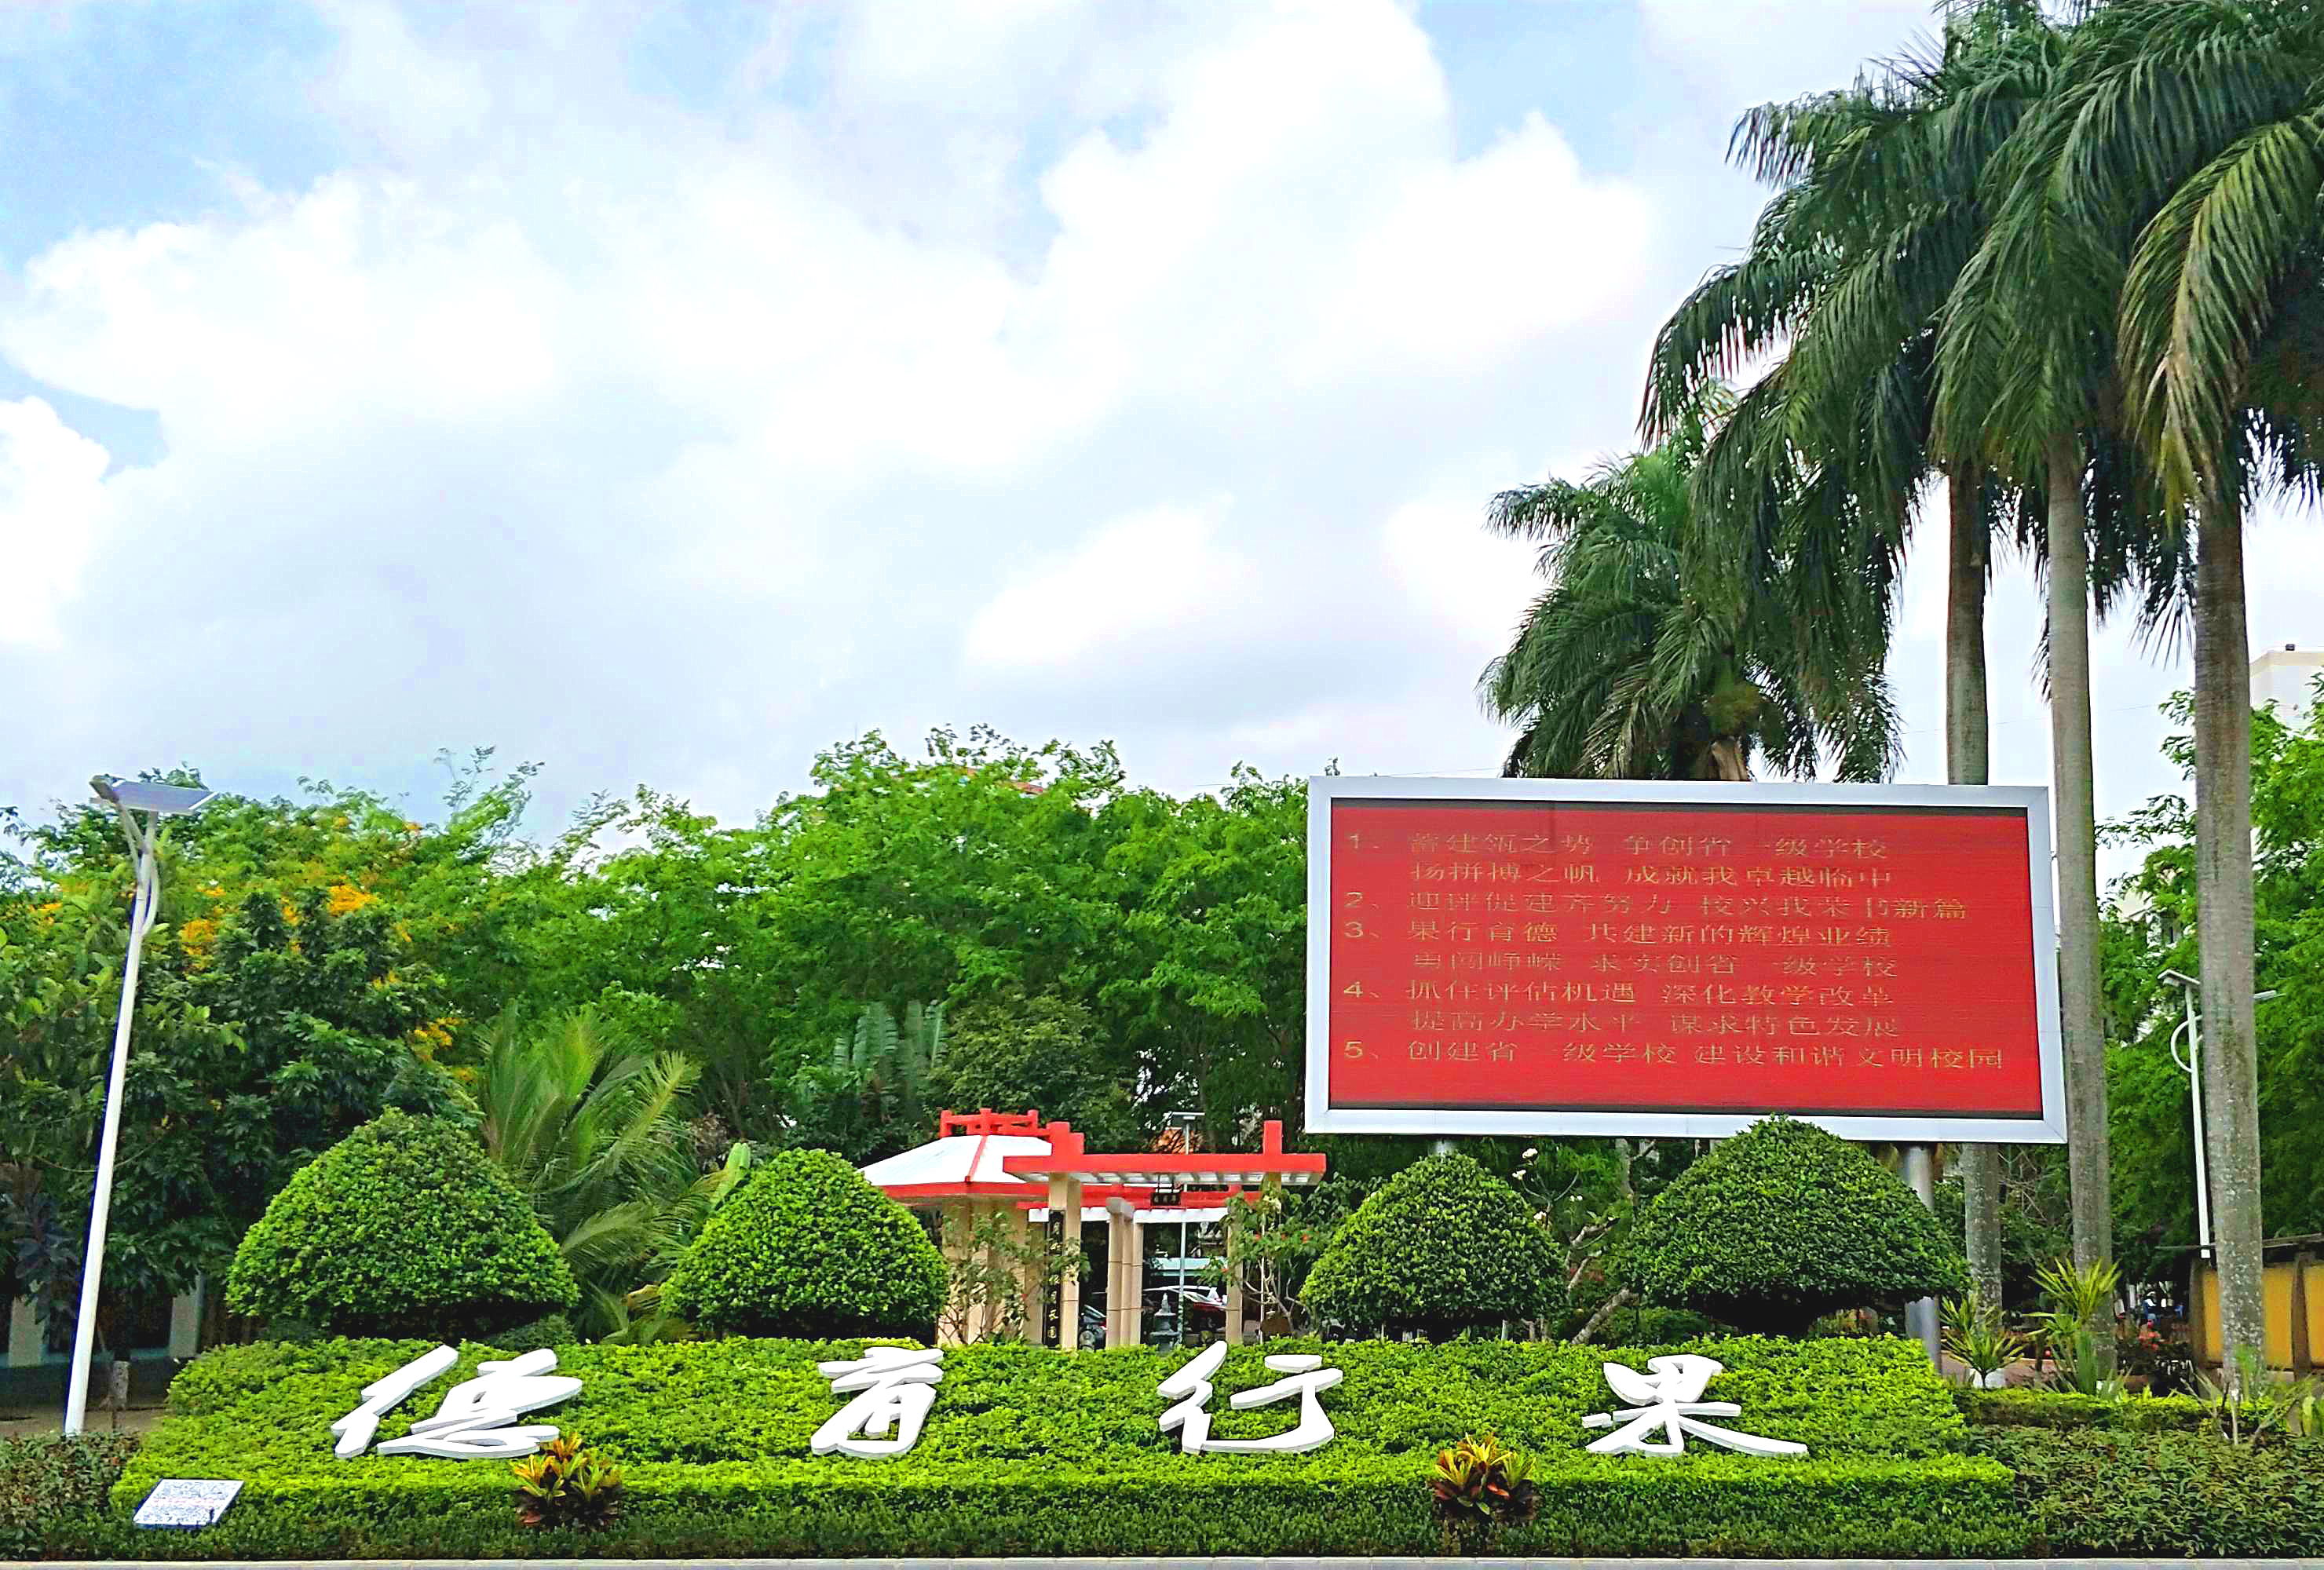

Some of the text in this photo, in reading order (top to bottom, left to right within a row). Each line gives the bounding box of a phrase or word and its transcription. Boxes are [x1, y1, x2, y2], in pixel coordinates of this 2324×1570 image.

[1410, 921, 1558, 943] 果行育德
[1591, 954, 1896, 977] 求实创省级学校
[1405, 980, 1636, 1002] 抓住评估机遇
[1661, 983, 1893, 1006] 深化教学改革
[1409, 1041, 1677, 1064] 创建省级学校
